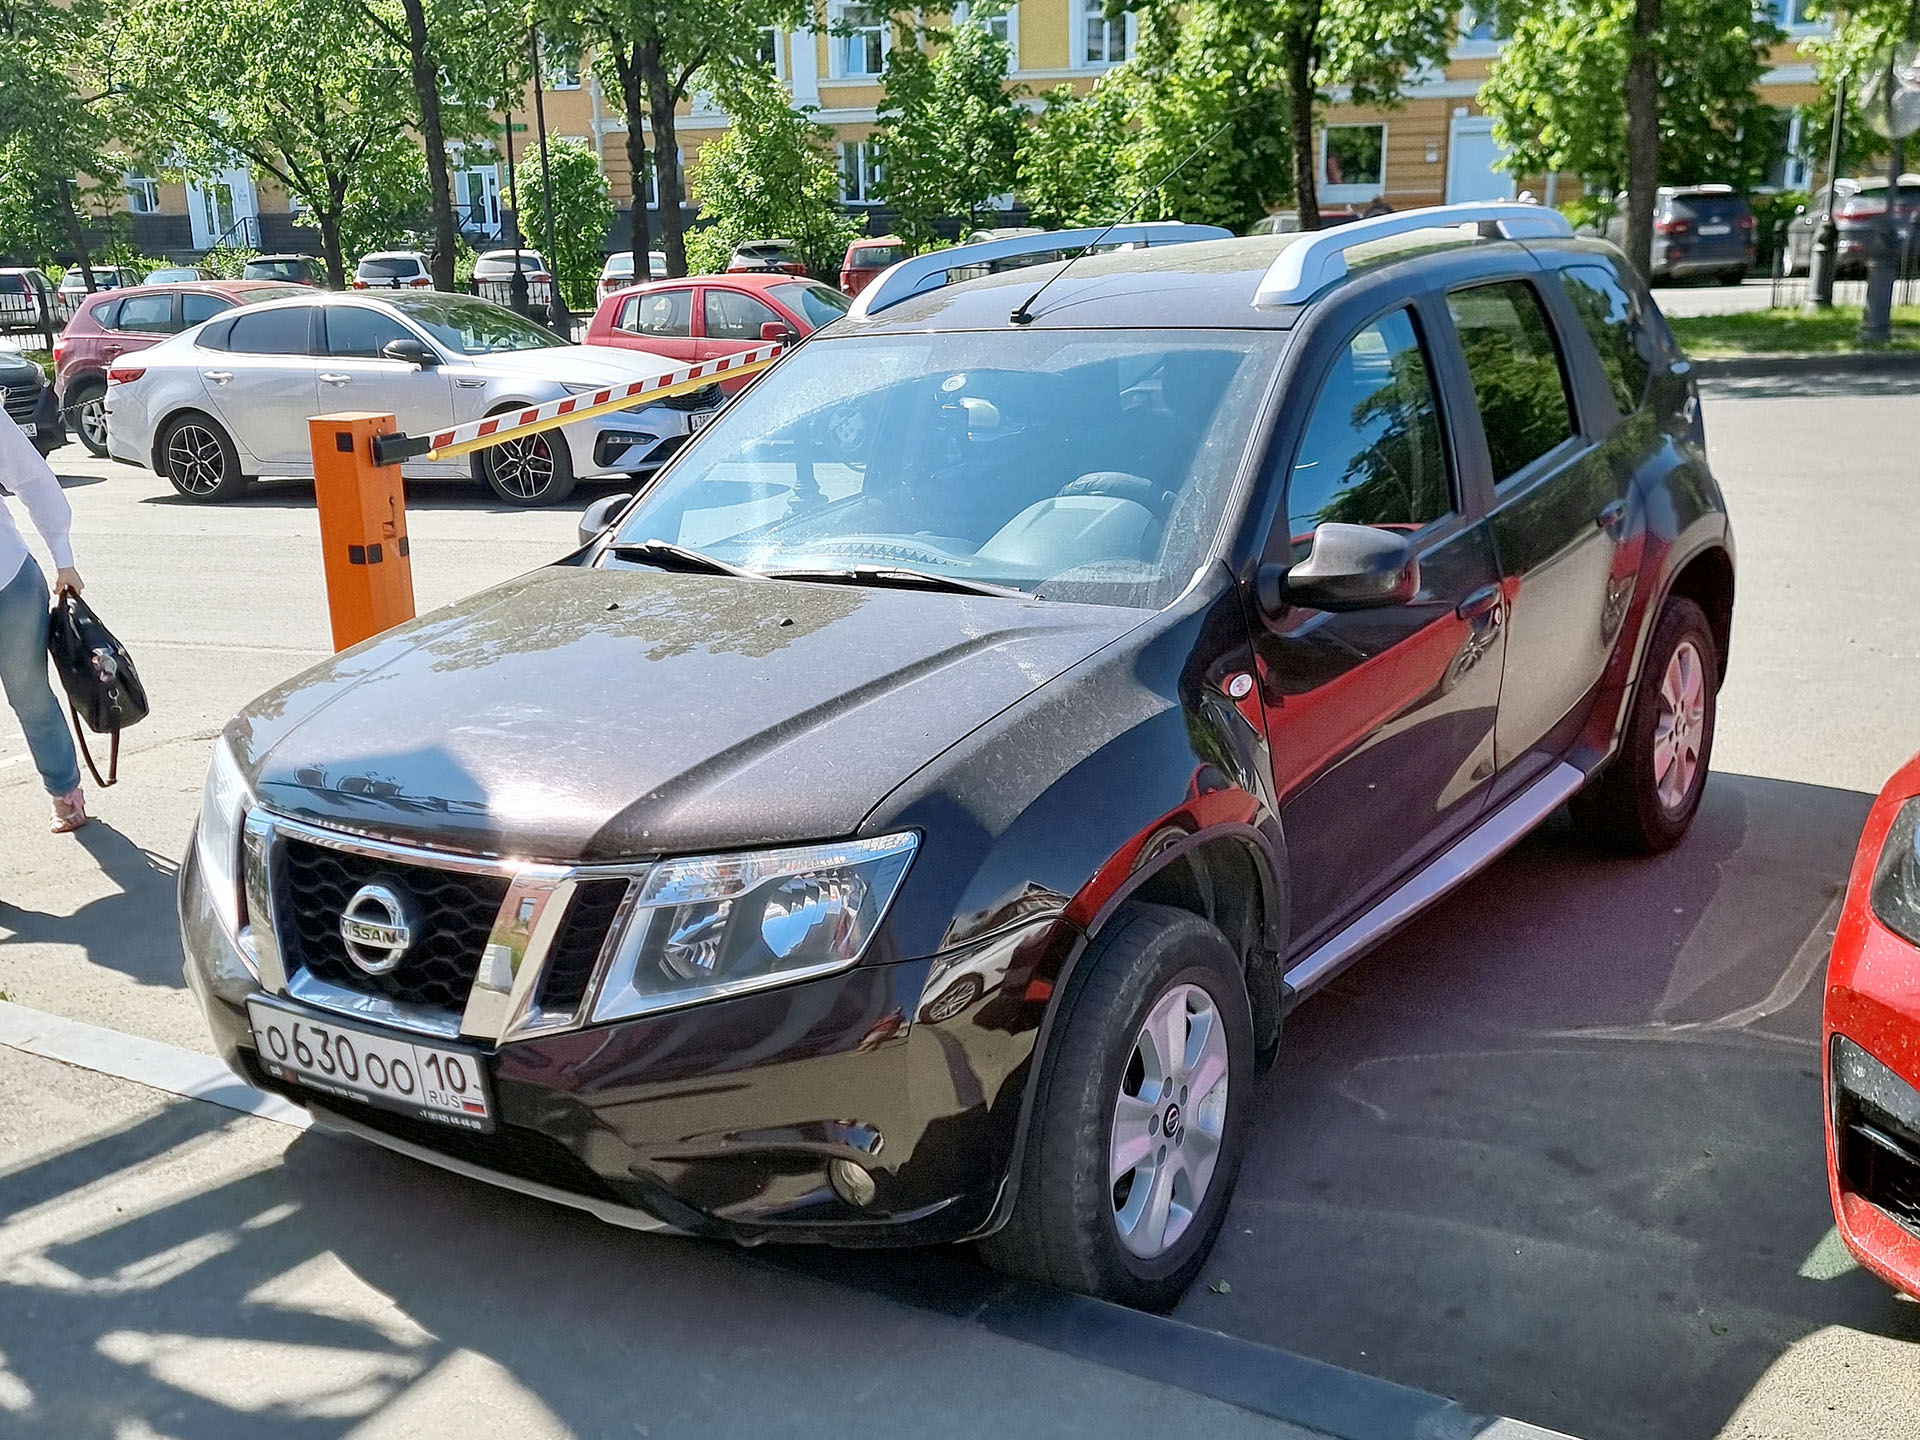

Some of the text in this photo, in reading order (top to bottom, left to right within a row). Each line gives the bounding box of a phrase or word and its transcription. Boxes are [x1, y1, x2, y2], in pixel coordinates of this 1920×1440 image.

[342, 919, 396, 944] NISSAN
[424, 1052, 467, 1094] 10
[429, 1090, 461, 1109] RUS
